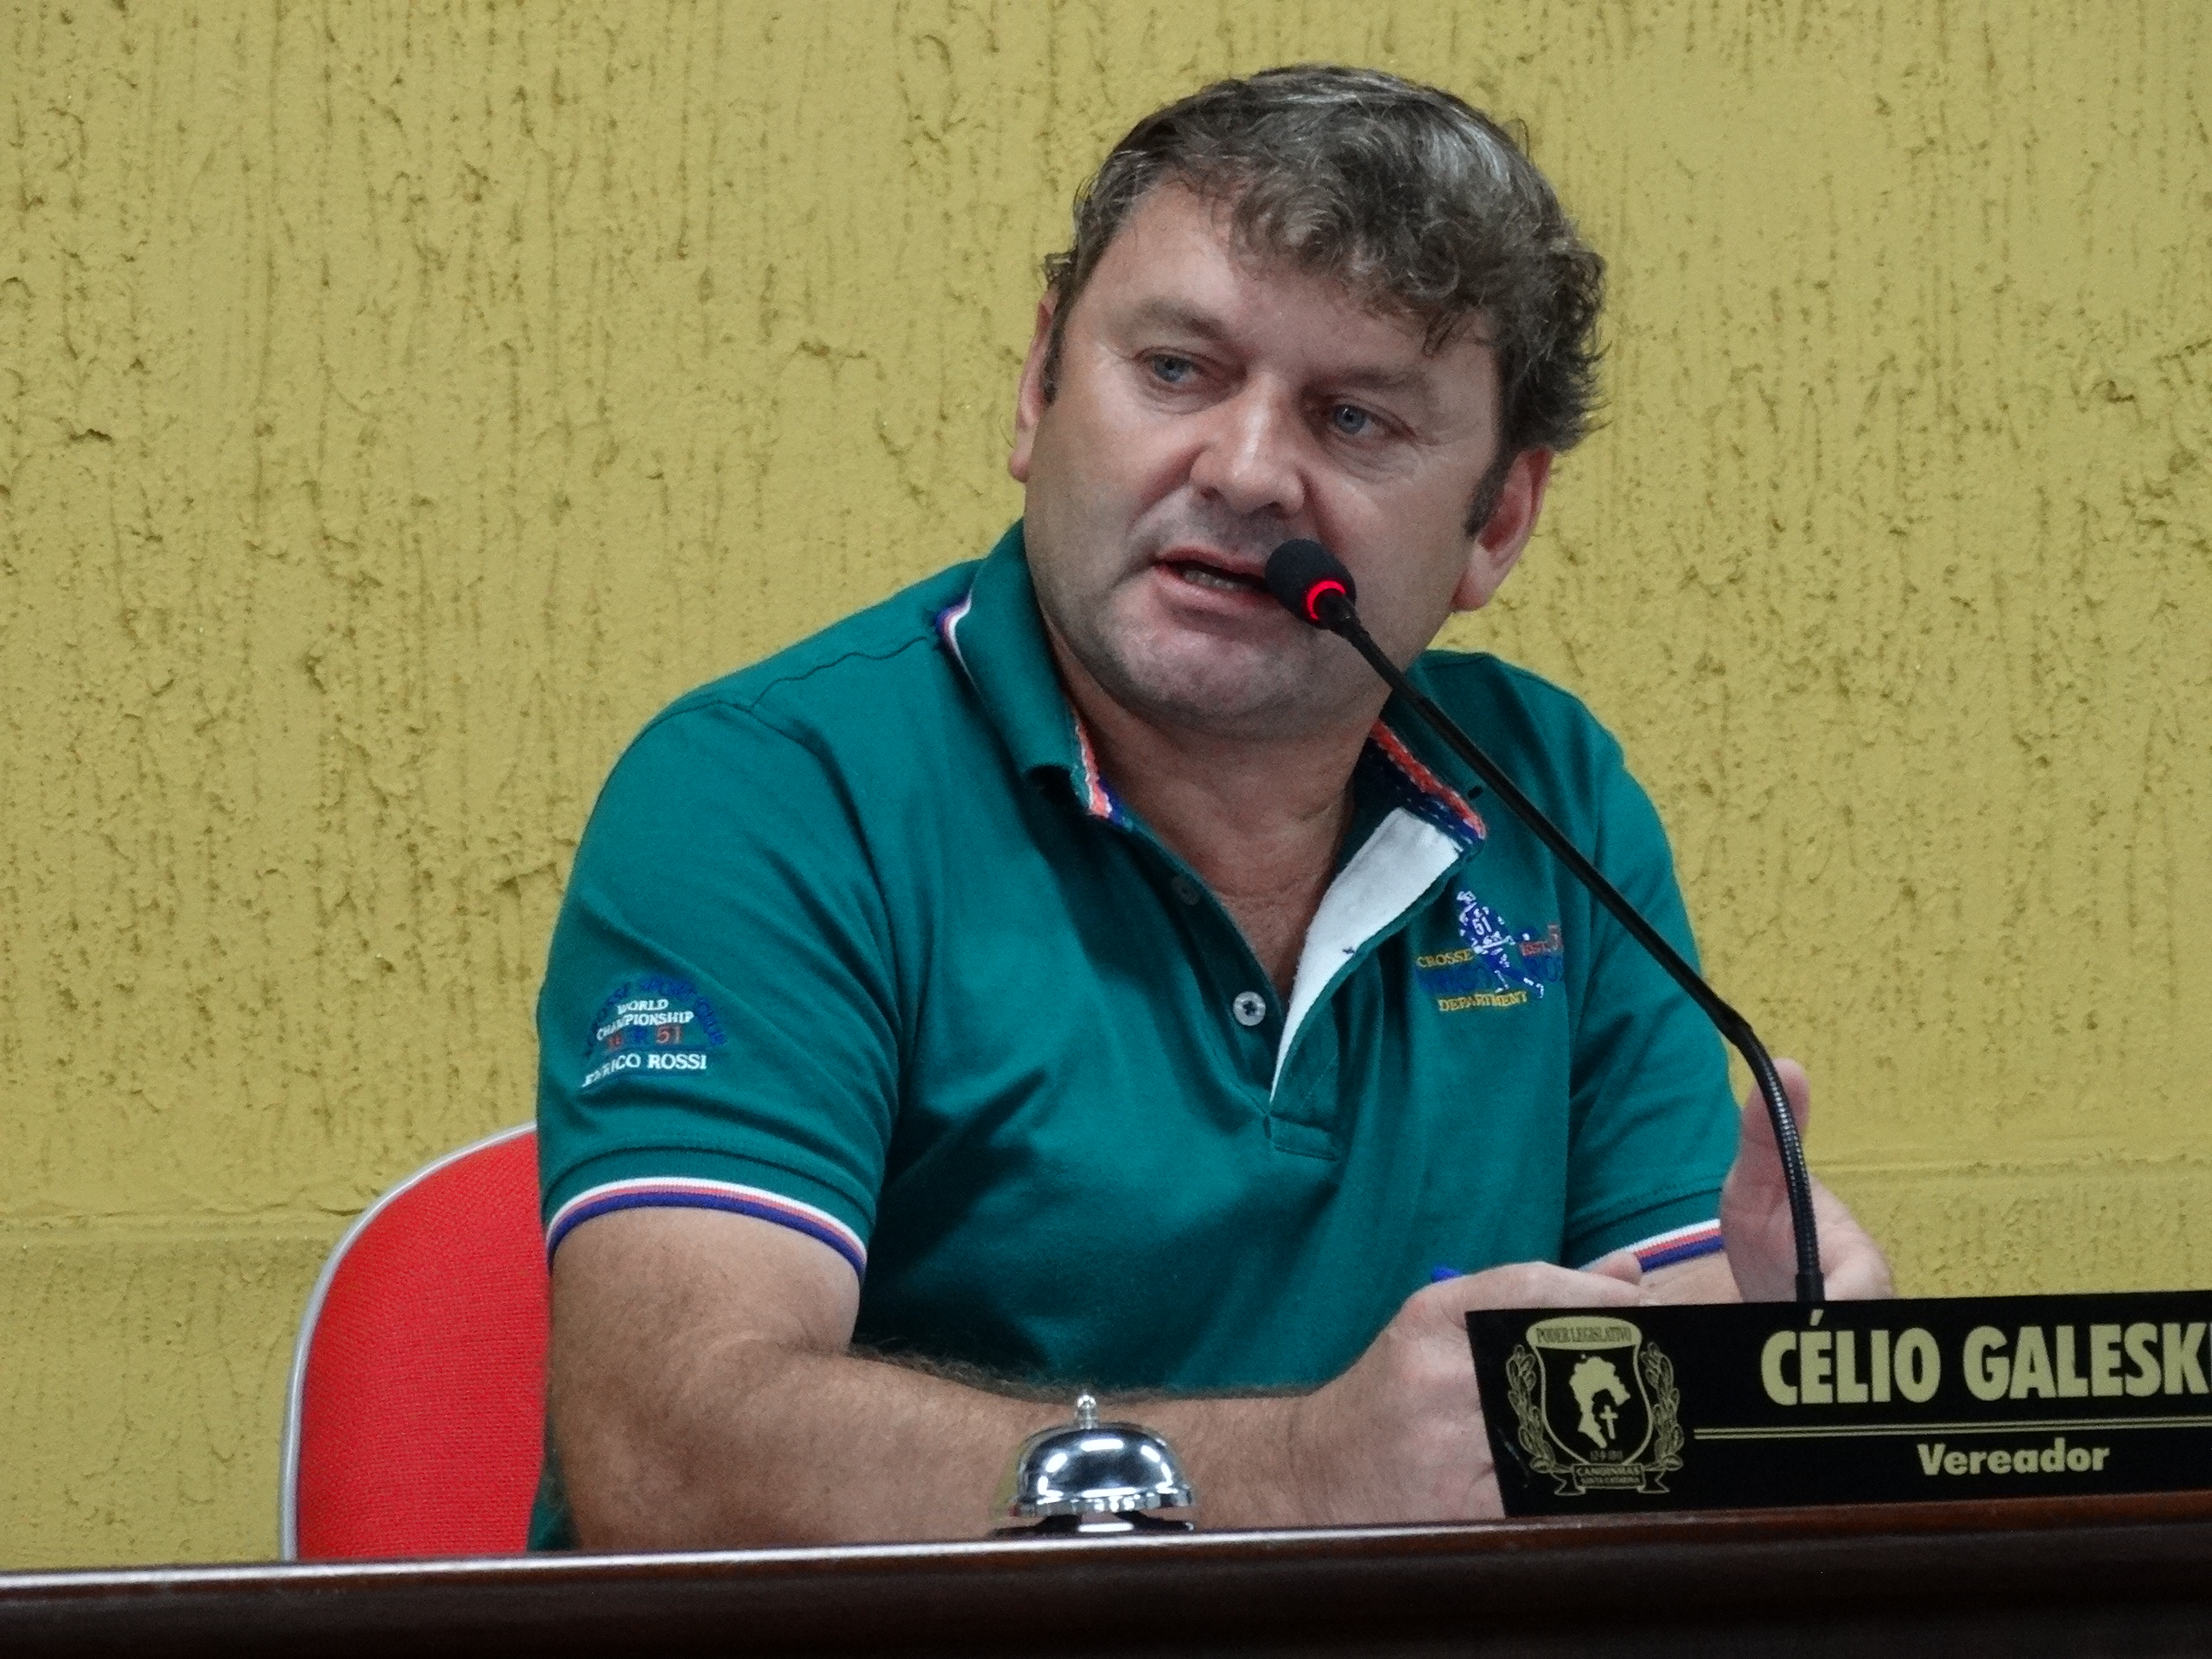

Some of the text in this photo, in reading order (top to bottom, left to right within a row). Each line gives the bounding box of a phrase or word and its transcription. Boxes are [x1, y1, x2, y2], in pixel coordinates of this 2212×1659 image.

[1416, 947, 1475, 968] CROSSE
[616, 998, 669, 1015] WORLD
[1438, 991, 1528, 1011] DEPARTMENT
[597, 1010, 695, 1041] CHAMPIONSHIP
[646, 1053, 707, 1070] ROSSI
[1535, 1326, 1633, 1343] PODER LEGISLATIVO
[1761, 1308, 2212, 1406] CÉLIO GALESK
[1917, 1436, 2110, 1476] Vereador
